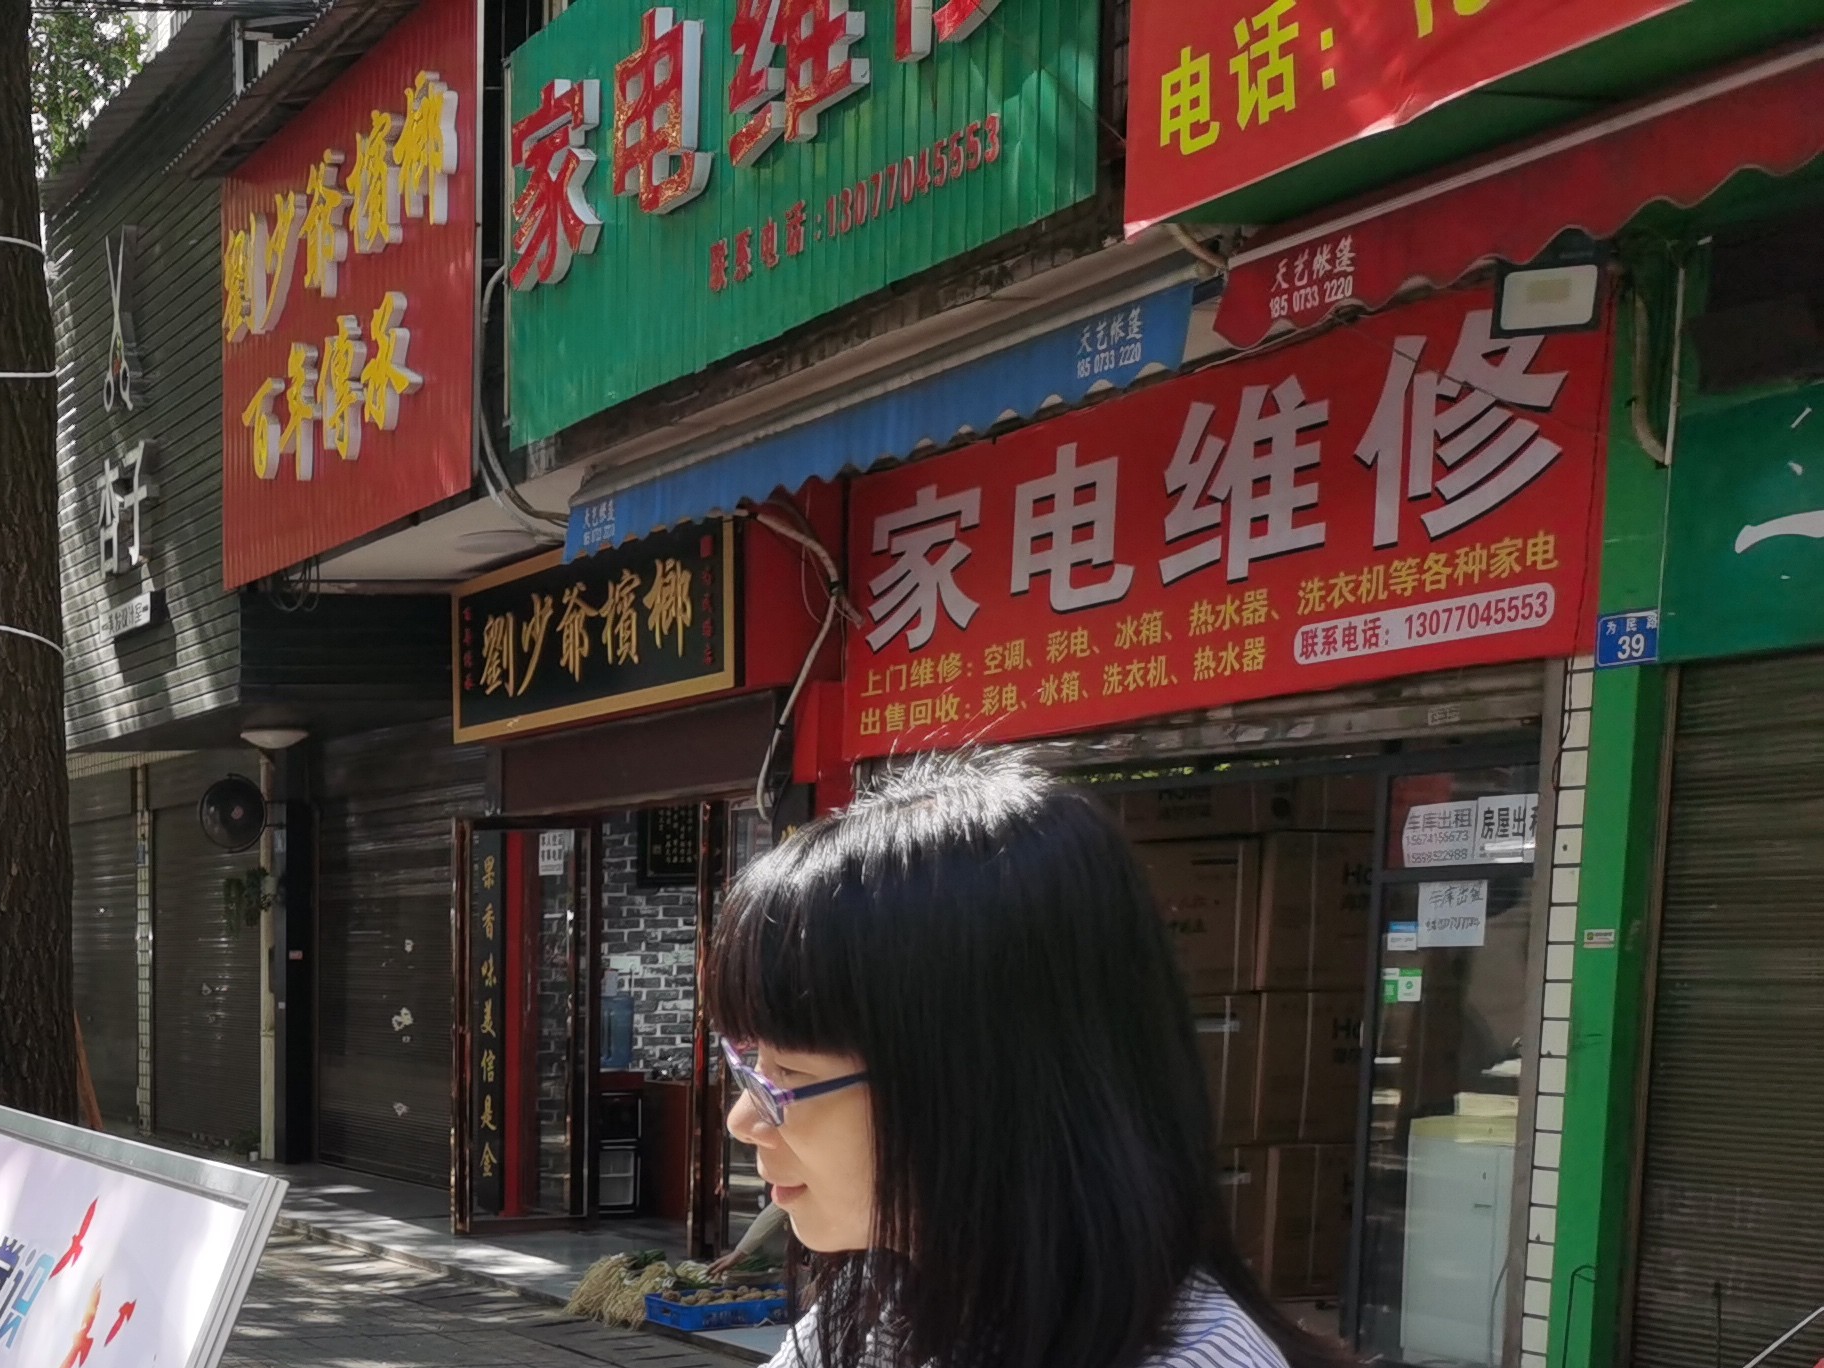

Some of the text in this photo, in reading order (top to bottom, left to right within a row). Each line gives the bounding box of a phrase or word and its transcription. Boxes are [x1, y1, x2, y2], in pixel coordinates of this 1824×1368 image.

[511, 0, 998, 291] 家电维
[1270, 275, 1353, 318] 185 0733 2220
[1077, 342, 1141, 379] 185 0733 2220
[866, 310, 1569, 655] 家电维修
[1606, 616, 1658, 636] 为民路
[1617, 634, 1645, 660] 39
